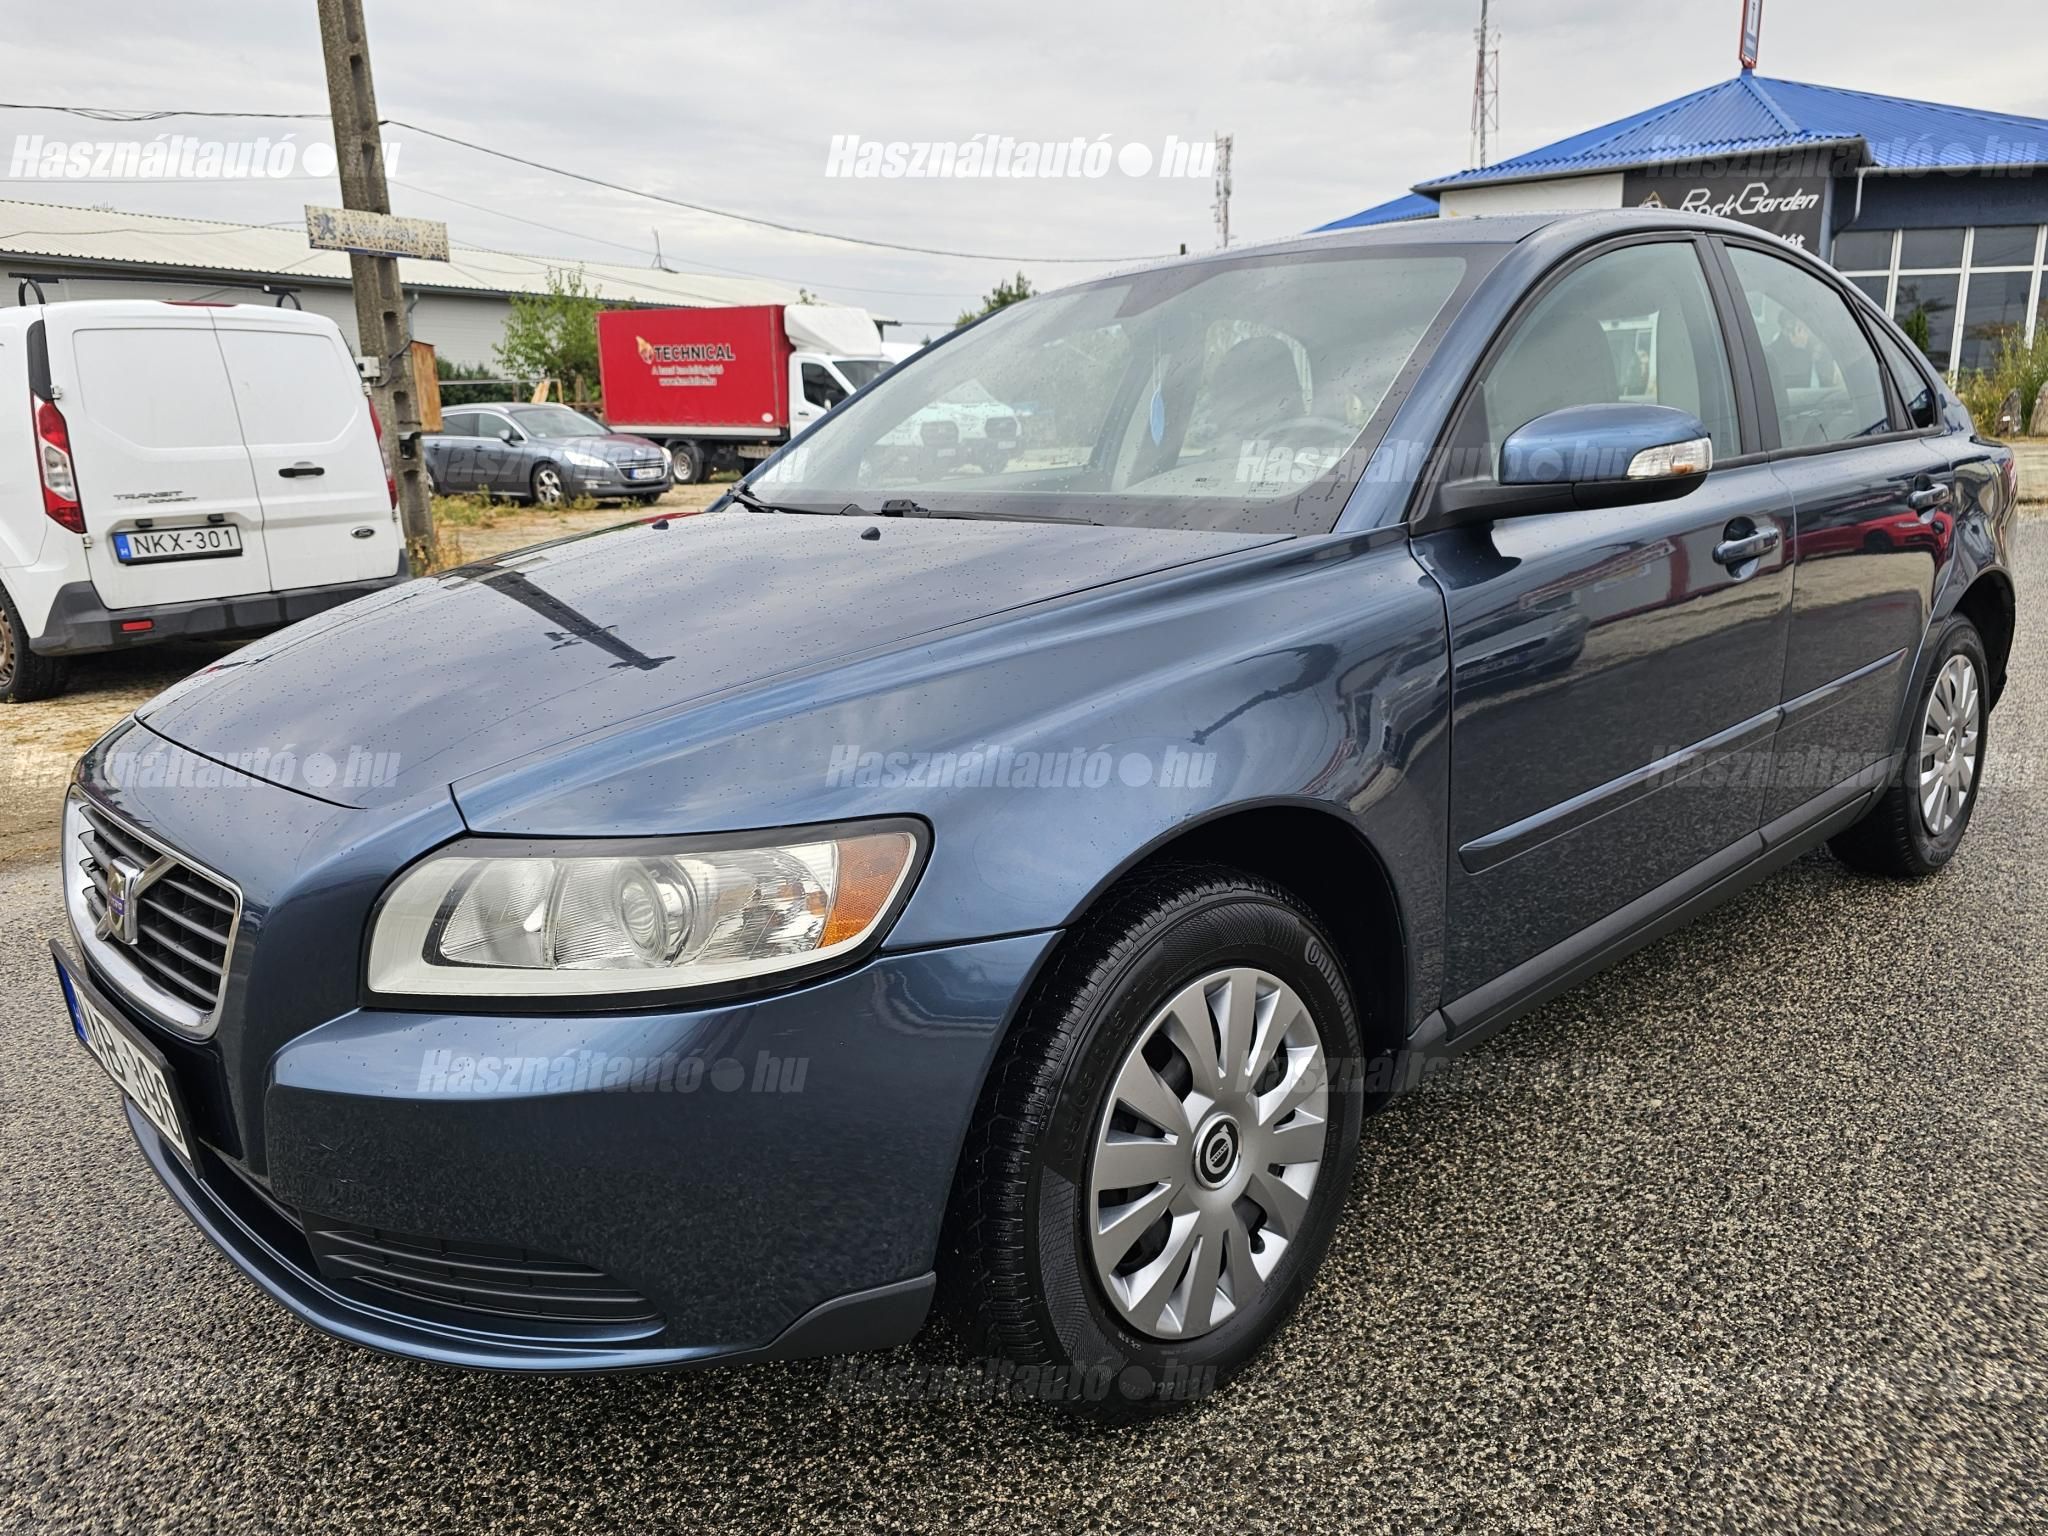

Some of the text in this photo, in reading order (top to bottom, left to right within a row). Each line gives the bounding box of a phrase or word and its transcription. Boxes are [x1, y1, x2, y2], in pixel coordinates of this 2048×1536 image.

[654, 345, 735, 361] TECHNICAL
[113, 490, 183, 500] TRANSIT
[133, 530, 233, 554] NKX-301
